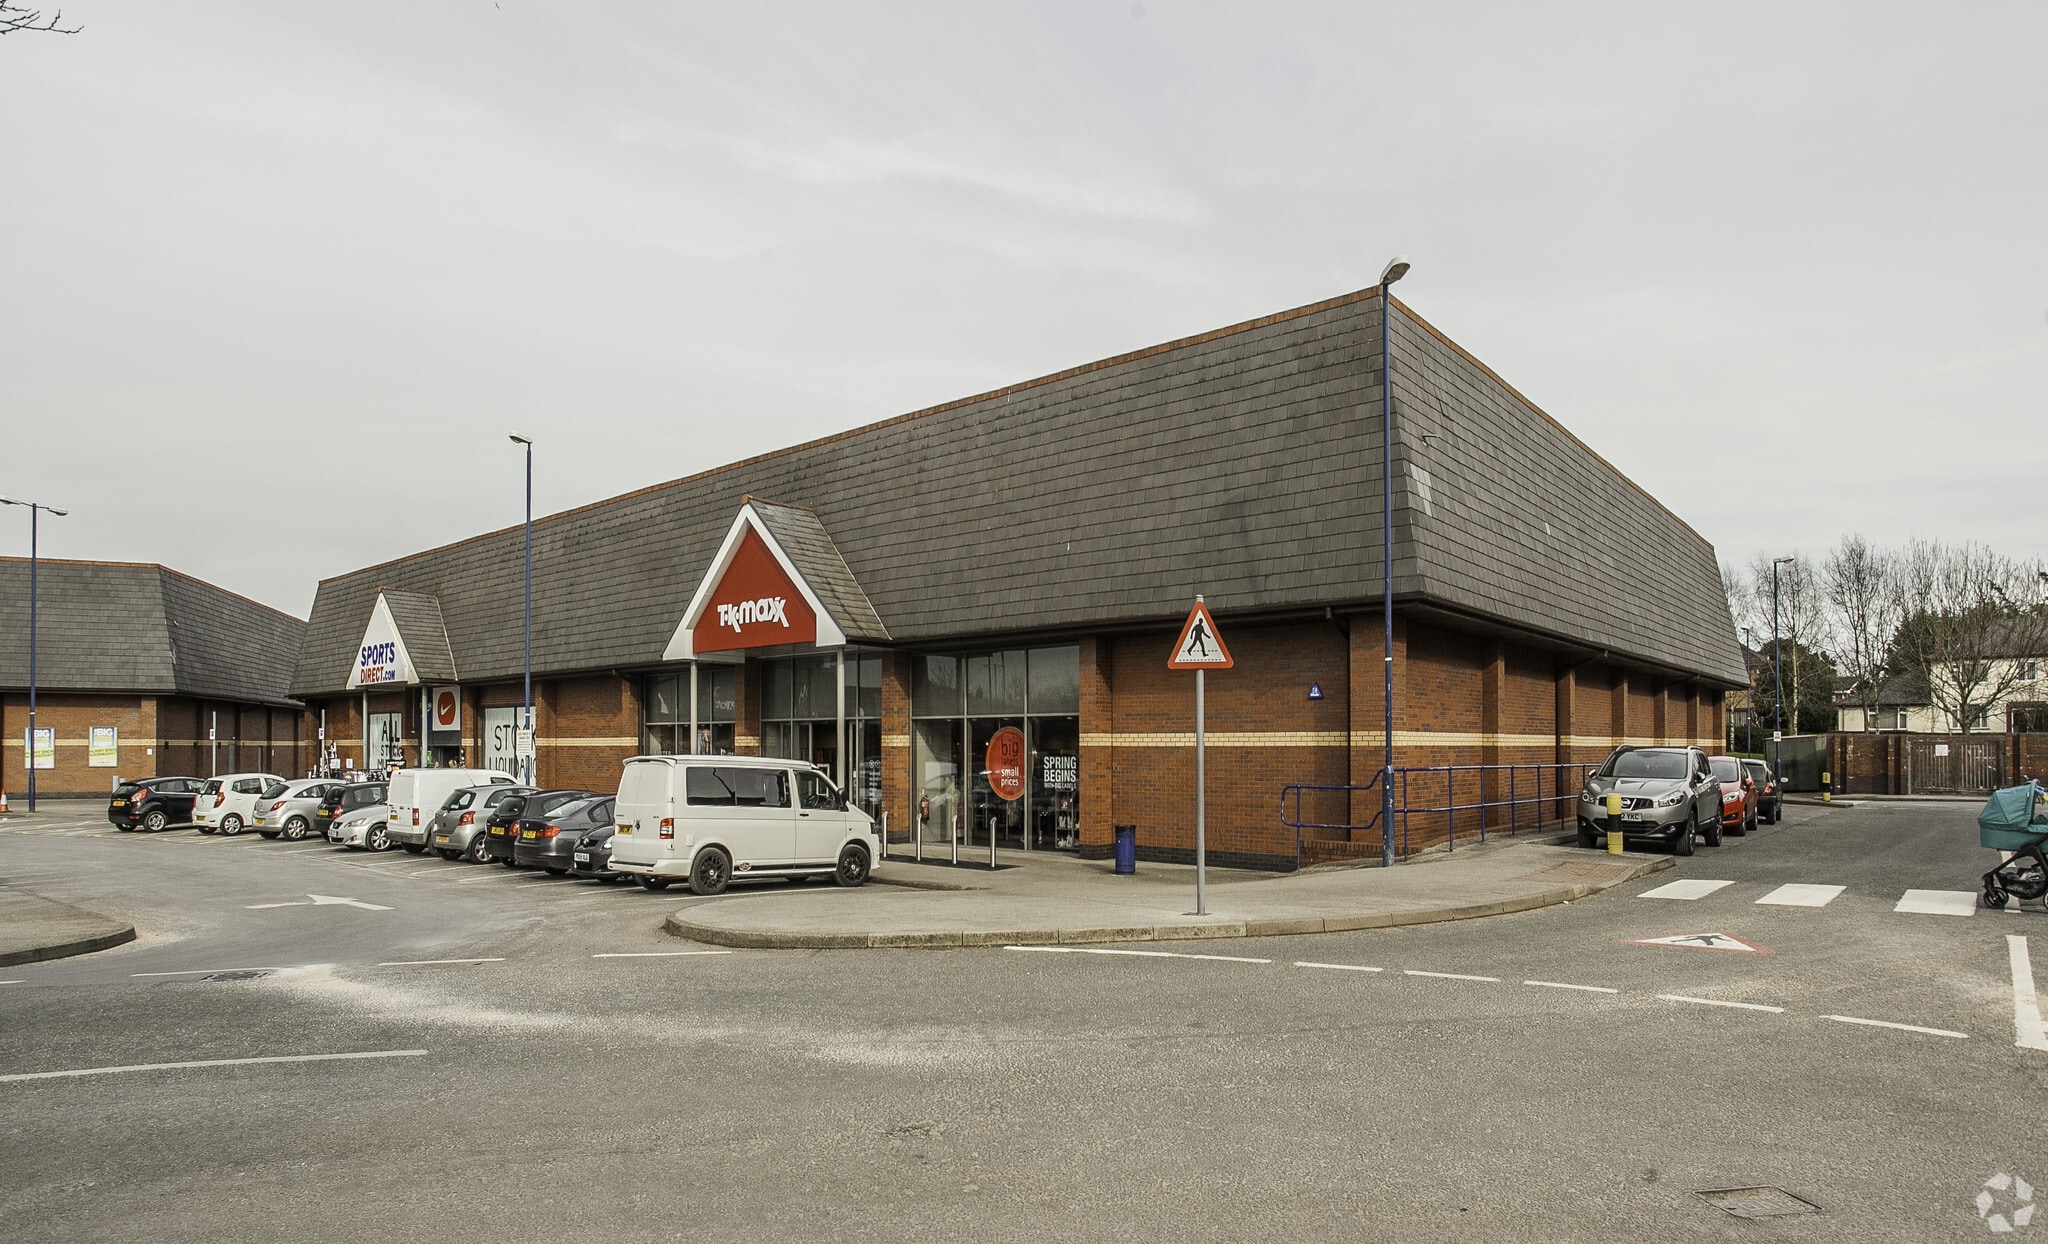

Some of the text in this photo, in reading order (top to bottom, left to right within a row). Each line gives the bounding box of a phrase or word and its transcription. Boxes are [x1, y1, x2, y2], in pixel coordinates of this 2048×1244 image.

[361, 641, 395, 667] SPORTS
[360, 667, 395, 684] DIRECT.COM
[97, 728, 113, 736] BIG
[1002, 739, 1018, 757] big
[1043, 756, 1076, 769] SPRING
[1001, 767, 1019, 777] small
[1044, 770, 1076, 782] BEGINS
[1001, 777, 1018, 787] prices
[1626, 812, 1639, 820] YKC
